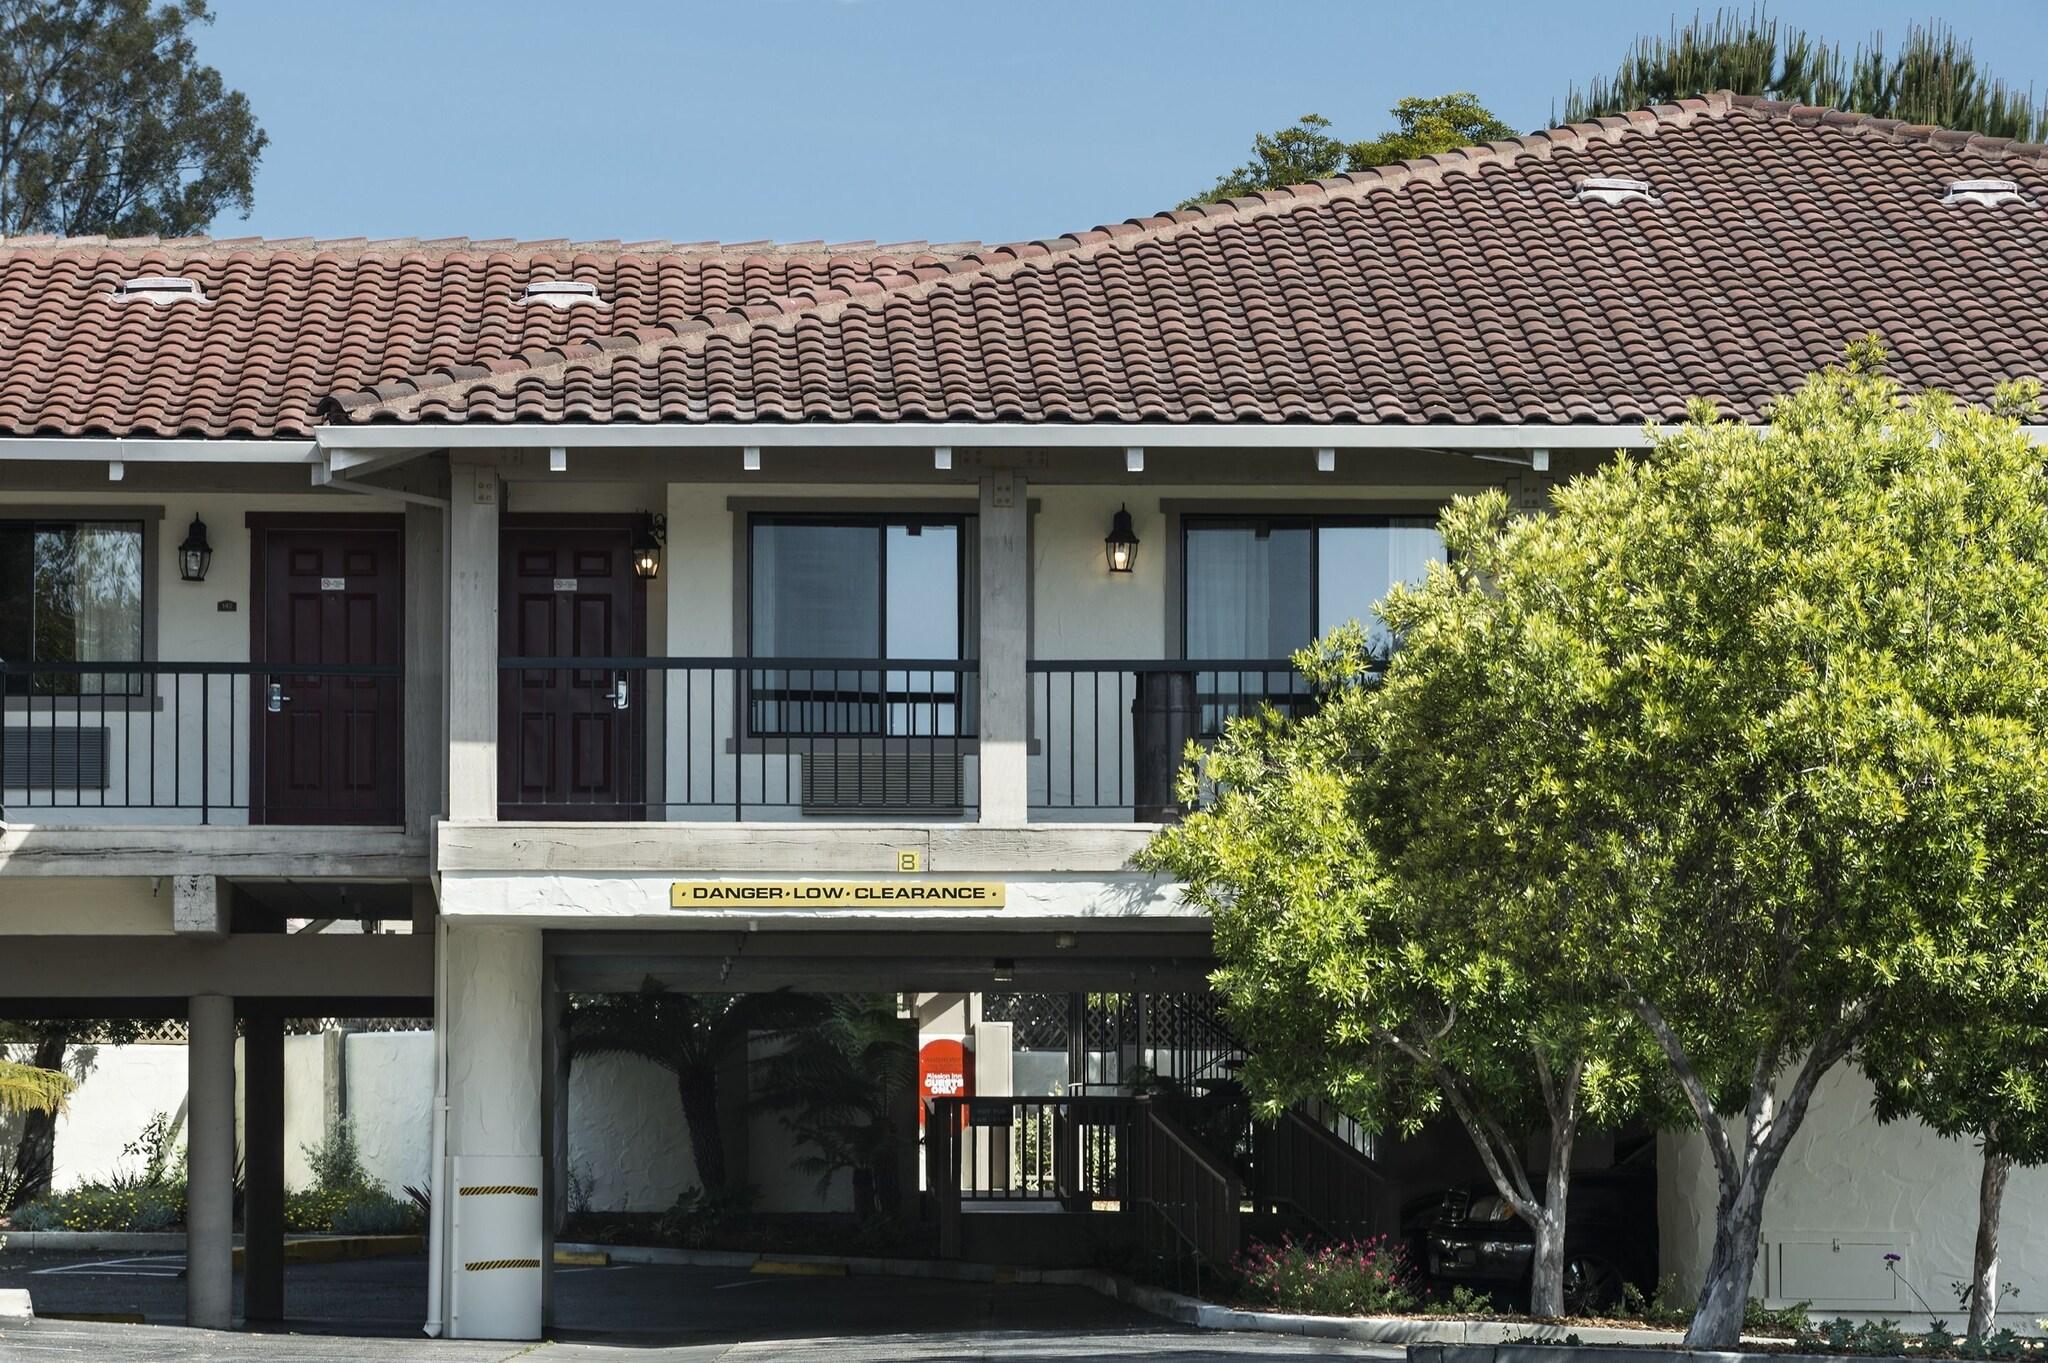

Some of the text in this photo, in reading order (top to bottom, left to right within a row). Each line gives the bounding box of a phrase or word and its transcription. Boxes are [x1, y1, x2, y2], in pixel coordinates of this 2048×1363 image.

[902, 854, 915, 870] 8
[693, 887, 985, 899] DANGER LOW CLEARANCE
[925, 1079, 964, 1088] GUESTS
[931, 1086, 957, 1095] ONLY
